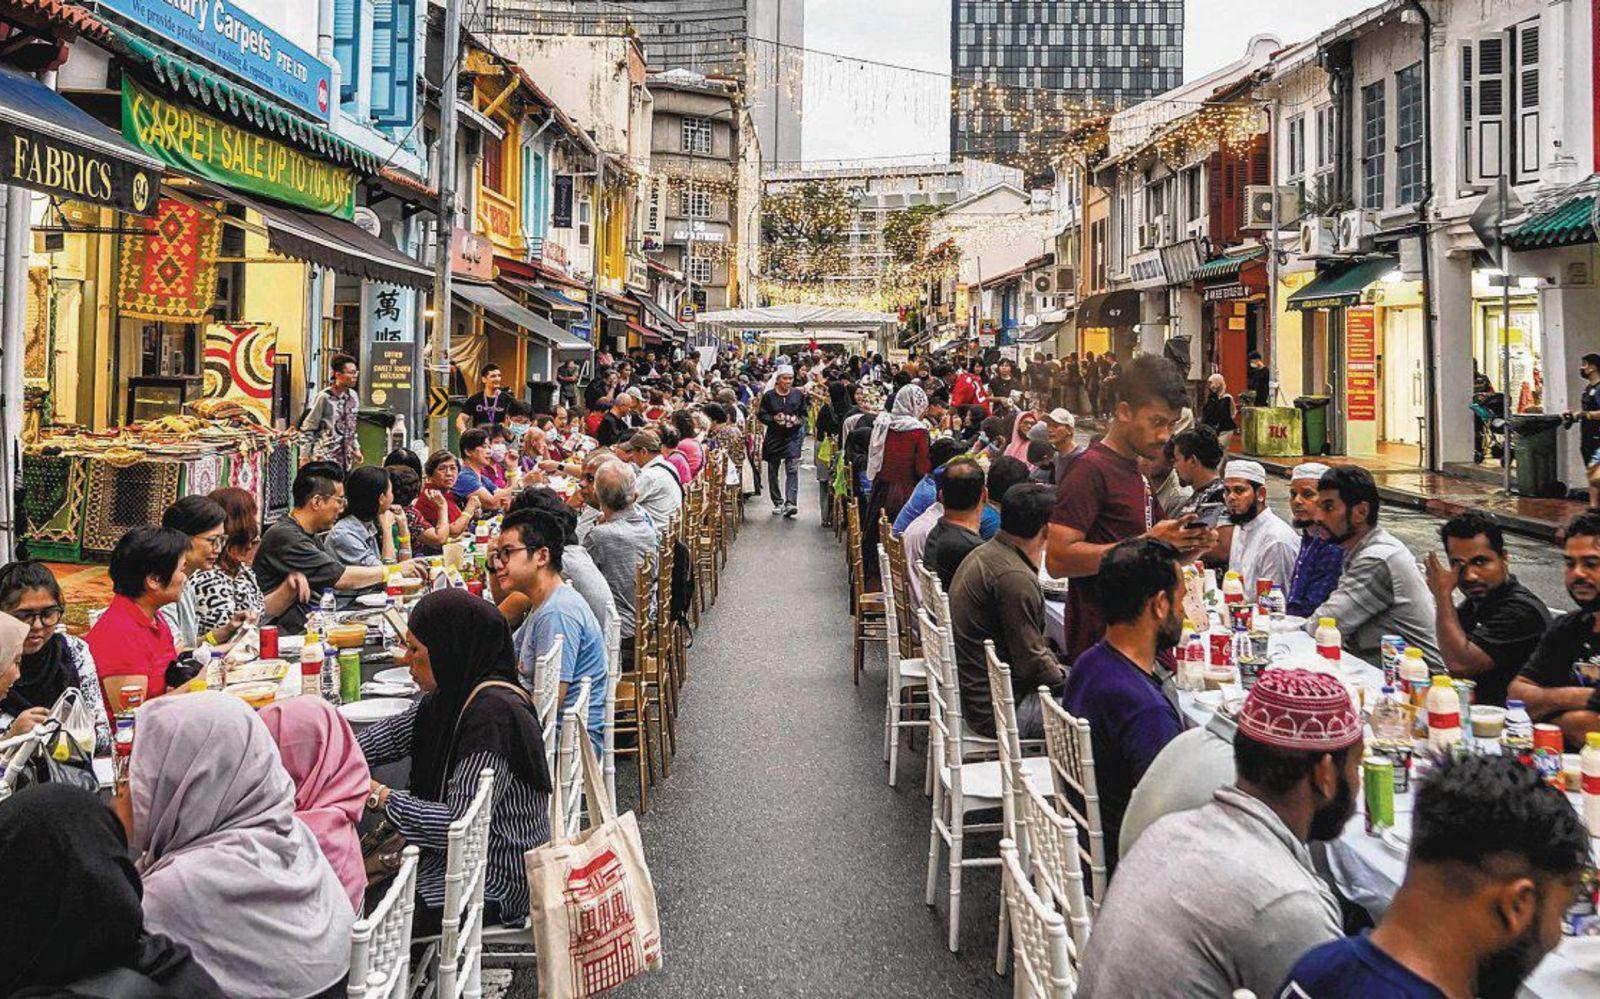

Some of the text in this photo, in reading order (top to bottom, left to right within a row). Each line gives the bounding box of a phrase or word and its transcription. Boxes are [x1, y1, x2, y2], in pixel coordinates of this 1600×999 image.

[147, 9, 176, 33] provide
[213, 0, 272, 62] Carpets
[276, 50, 294, 75] PTE
[293, 62, 309, 84] LTD
[12, 134, 113, 202] FABRICS
[134, 94, 352, 208] CARPET SALE UP TO 70% OFF
[134, 179, 149, 204] 84
[1269, 425, 1288, 439] TLK
